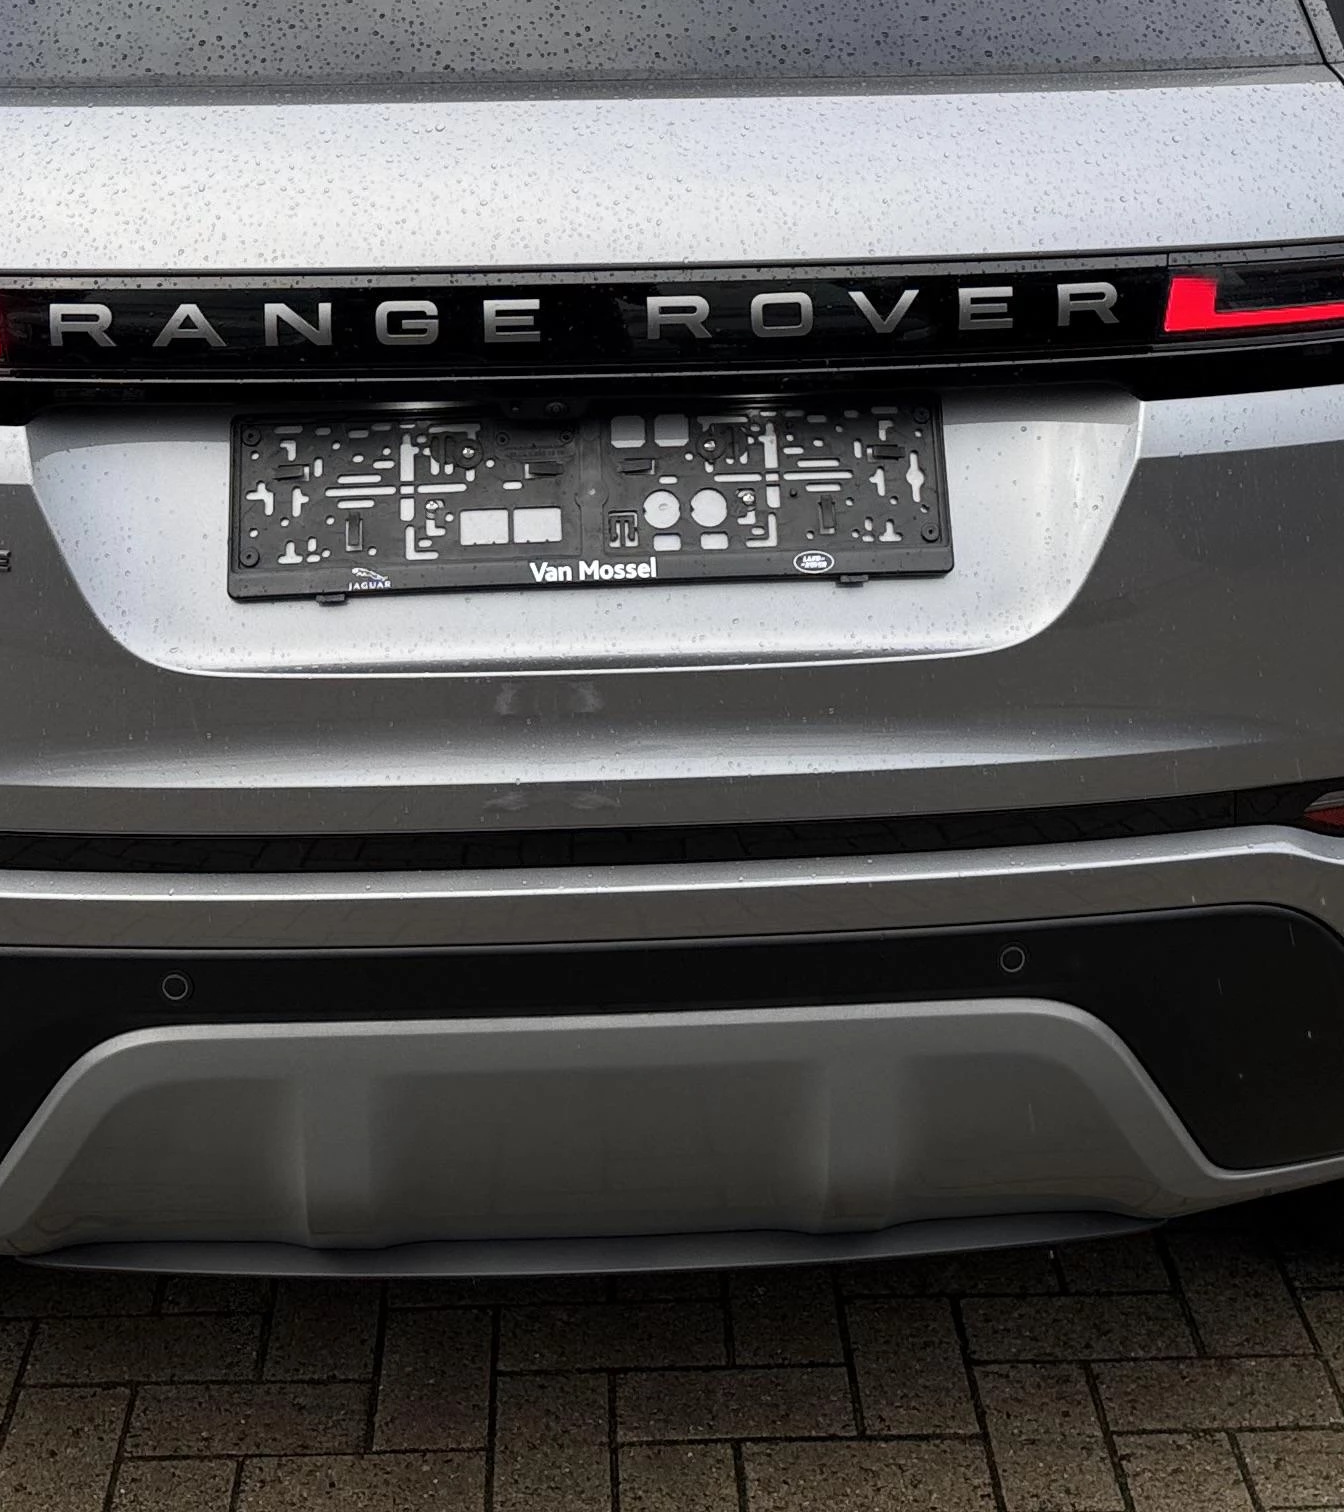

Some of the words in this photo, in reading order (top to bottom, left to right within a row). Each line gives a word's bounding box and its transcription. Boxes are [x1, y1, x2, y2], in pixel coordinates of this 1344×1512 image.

[47, 299, 544, 347] RANGE
[646, 281, 1121, 339] ROVER
[529, 561, 573, 583] Van
[578, 556, 657, 581] Mossel
[348, 580, 392, 592] JAGUAR
